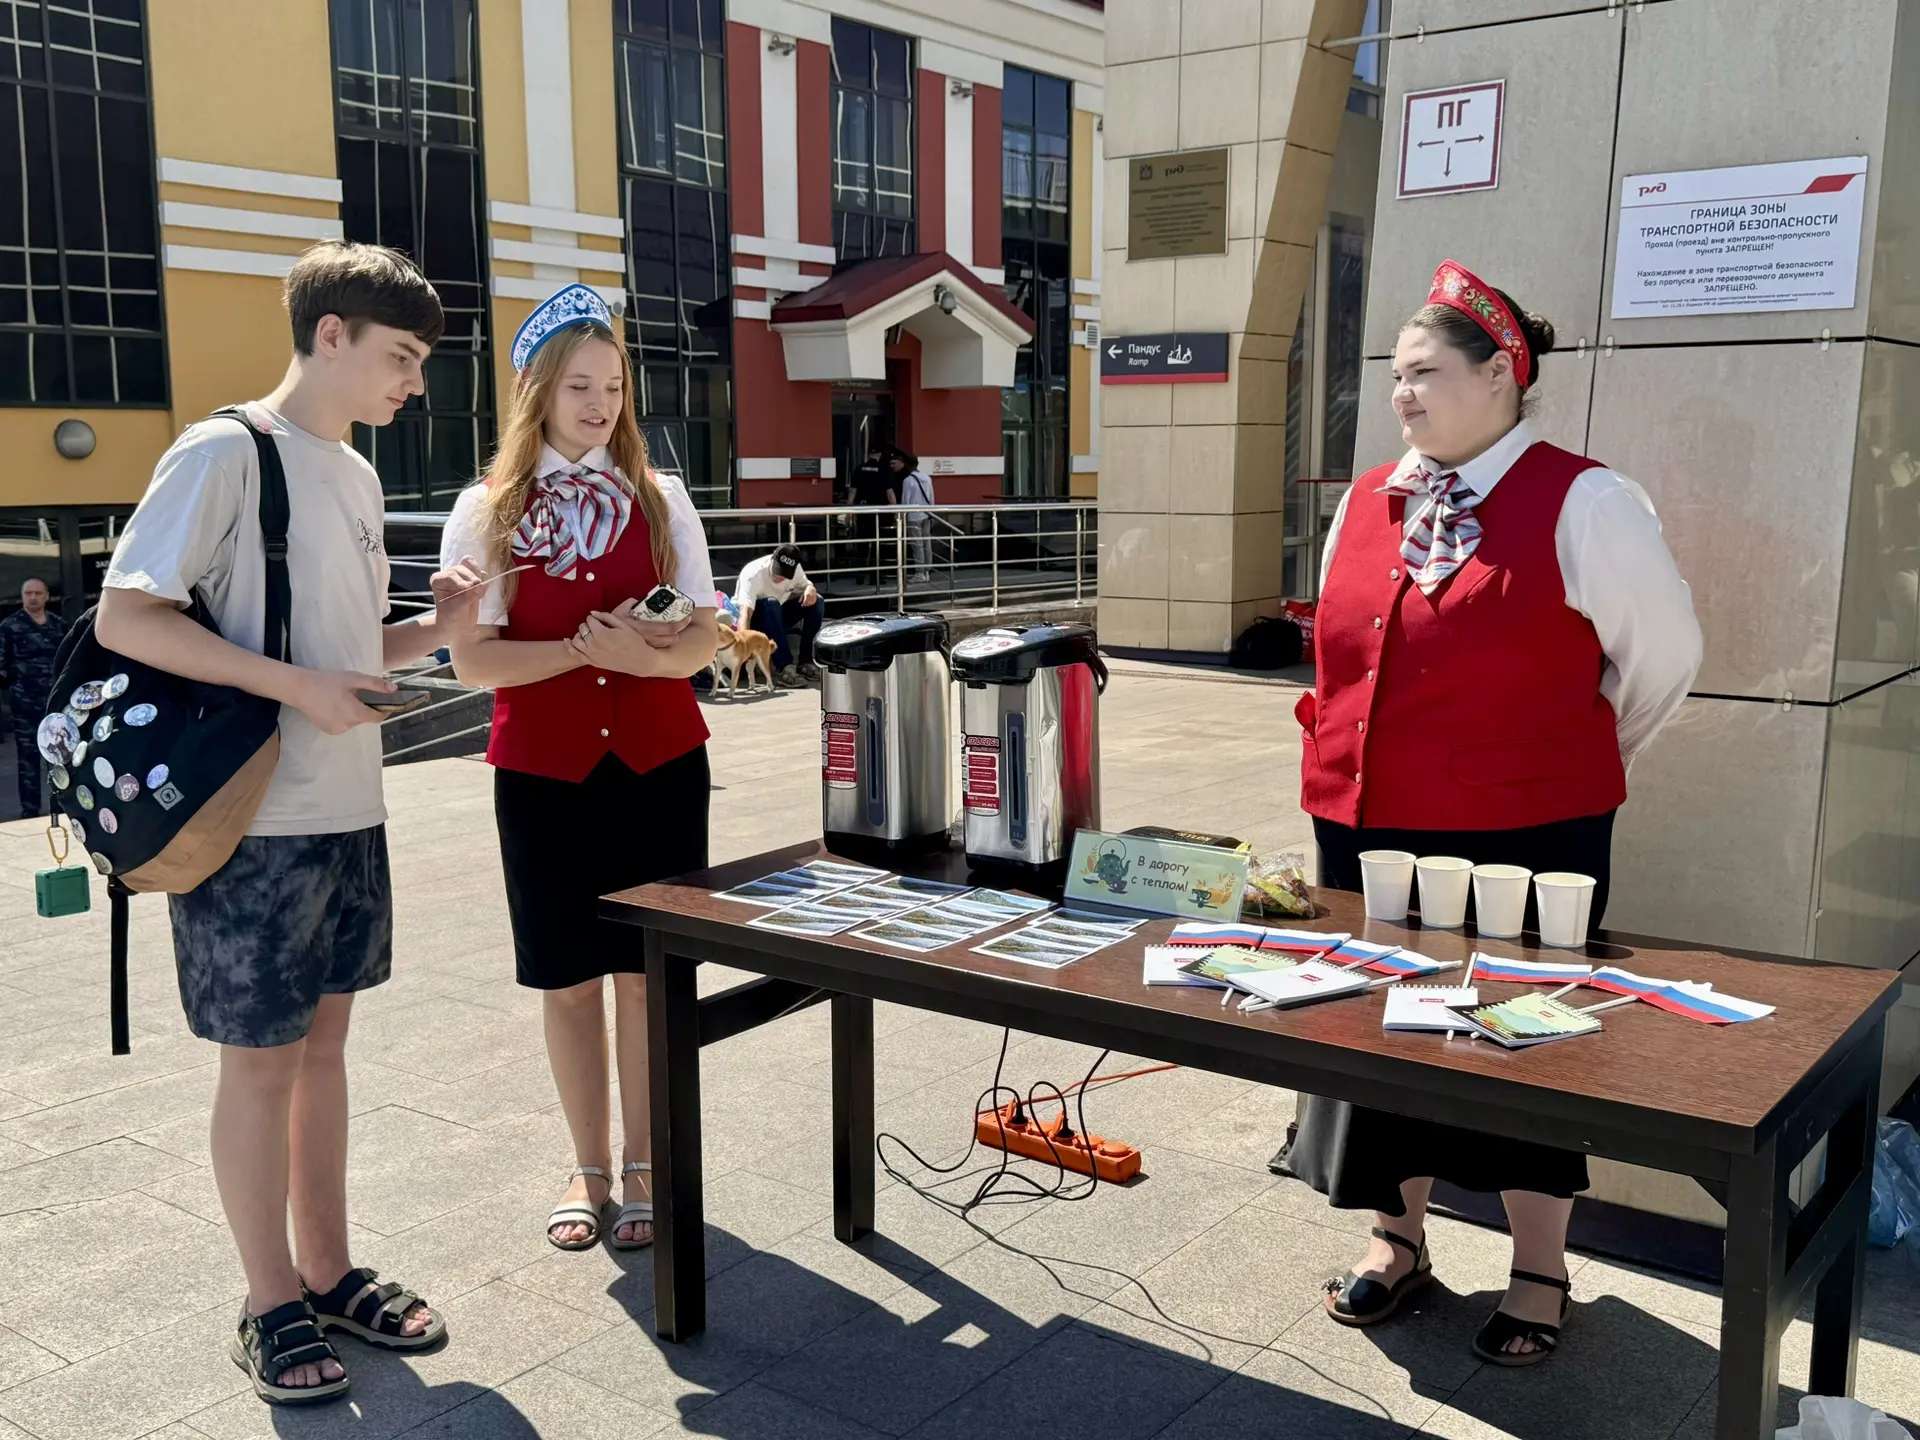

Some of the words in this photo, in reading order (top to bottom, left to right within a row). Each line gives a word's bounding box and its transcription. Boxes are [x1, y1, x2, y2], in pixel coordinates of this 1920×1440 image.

[1437, 98, 1471, 129] ПГ
[1690, 205, 1746, 219] ГРАНИЦА
[1750, 202, 1786, 216] ЗОНЫ
[1640, 219, 1735, 238] ТРАНСПОРТНОЙ
[1739, 214, 1838, 231] БЕЗОПАСНОСТИ
[1645, 240, 1674, 250] Проход
[1675, 237, 1709, 248] (проезд)
[1727, 230, 1831, 243] контрольно-пропускного
[1695, 247, 1723, 256] пункта
[1725, 243, 1774, 253] ЗАПРЕЩЕН!
[1637, 269, 1687, 278] Нахождение
[1716, 263, 1773, 273] транспортной
[1775, 260, 1834, 270] безопасности
[1643, 279, 1657, 287] без
[1659, 277, 1695, 287] пропуска
[1697, 276, 1713, 284] или
[1715, 272, 1776, 283] перевозочного
[1778, 270, 1824, 281] документа
[1704, 282, 1758, 293] ЗАПРЕЩЕНО.
[1128, 343, 1161, 356] Пандус
[1128, 358, 1149, 367] Ramp
[1138, 855, 1145, 867] В
[1149, 860, 1190, 876] дорогу
[1131, 876, 1138, 885] с
[1142, 877, 1189, 893] теплом!
